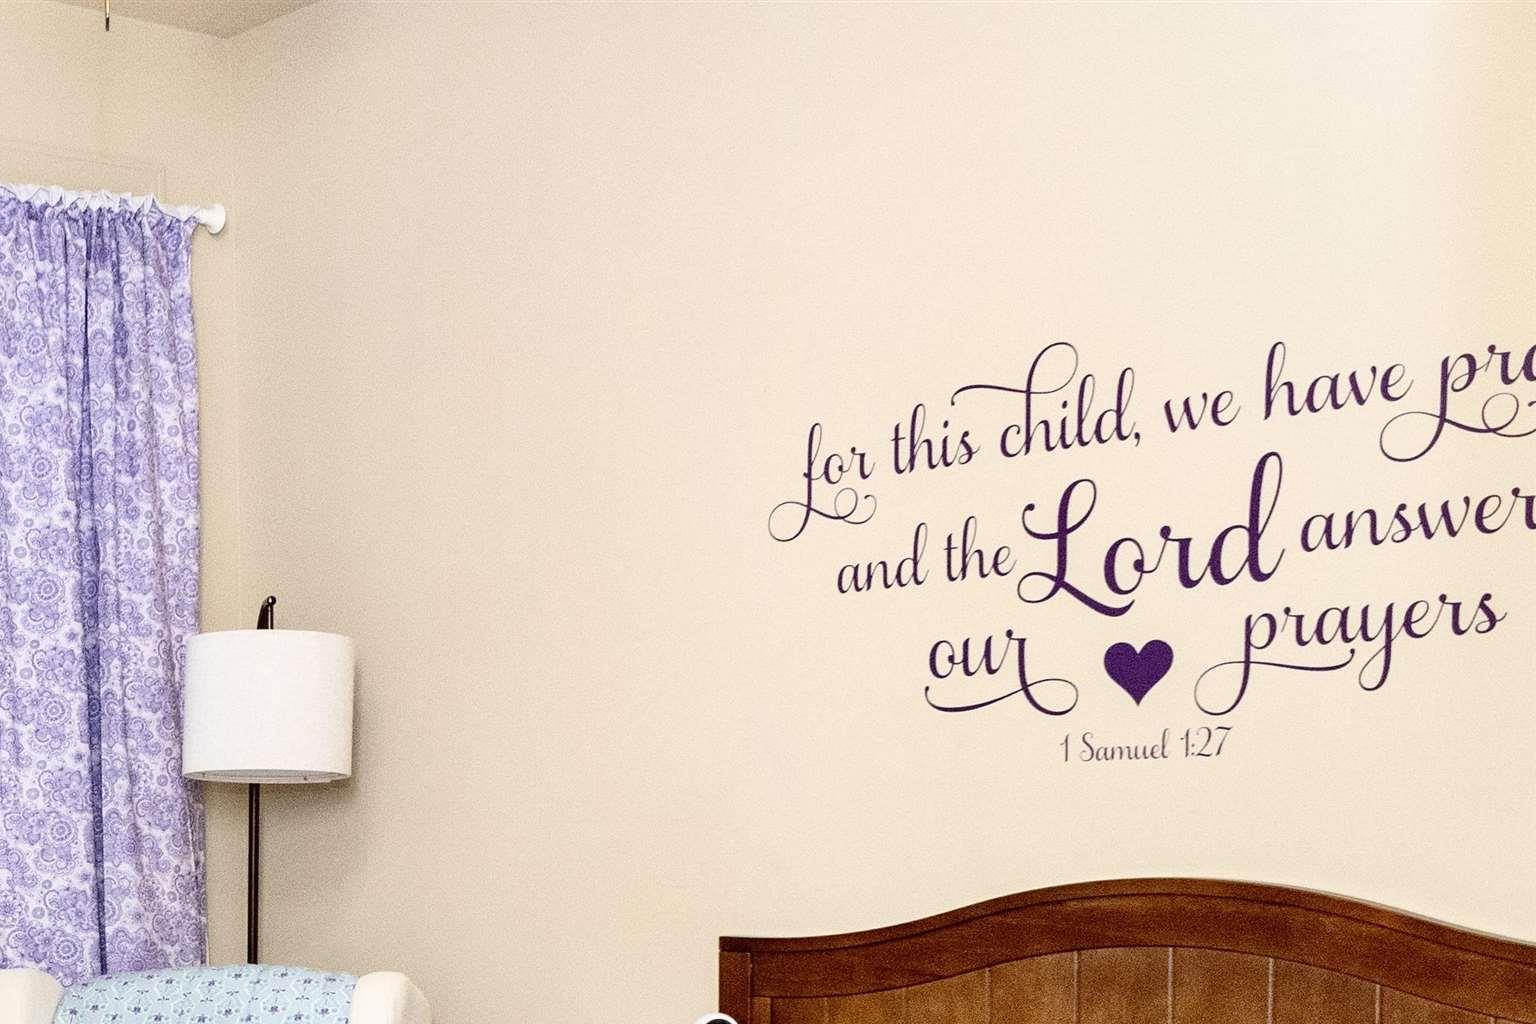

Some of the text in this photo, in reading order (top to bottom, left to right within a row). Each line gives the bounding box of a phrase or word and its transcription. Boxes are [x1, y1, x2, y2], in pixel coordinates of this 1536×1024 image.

[767, 422, 878, 542] for
[890, 403, 981, 475] this
[950, 341, 1142, 458] child,
[1163, 390, 1241, 433] we
[1264, 341, 1414, 421] have
[837, 522, 929, 594] and
[944, 516, 1017, 582] the
[1017, 451, 1285, 618] Lord
[924, 593, 1508, 716] our prayers
[1060, 726, 1233, 763] 1 Samuel 1:27
